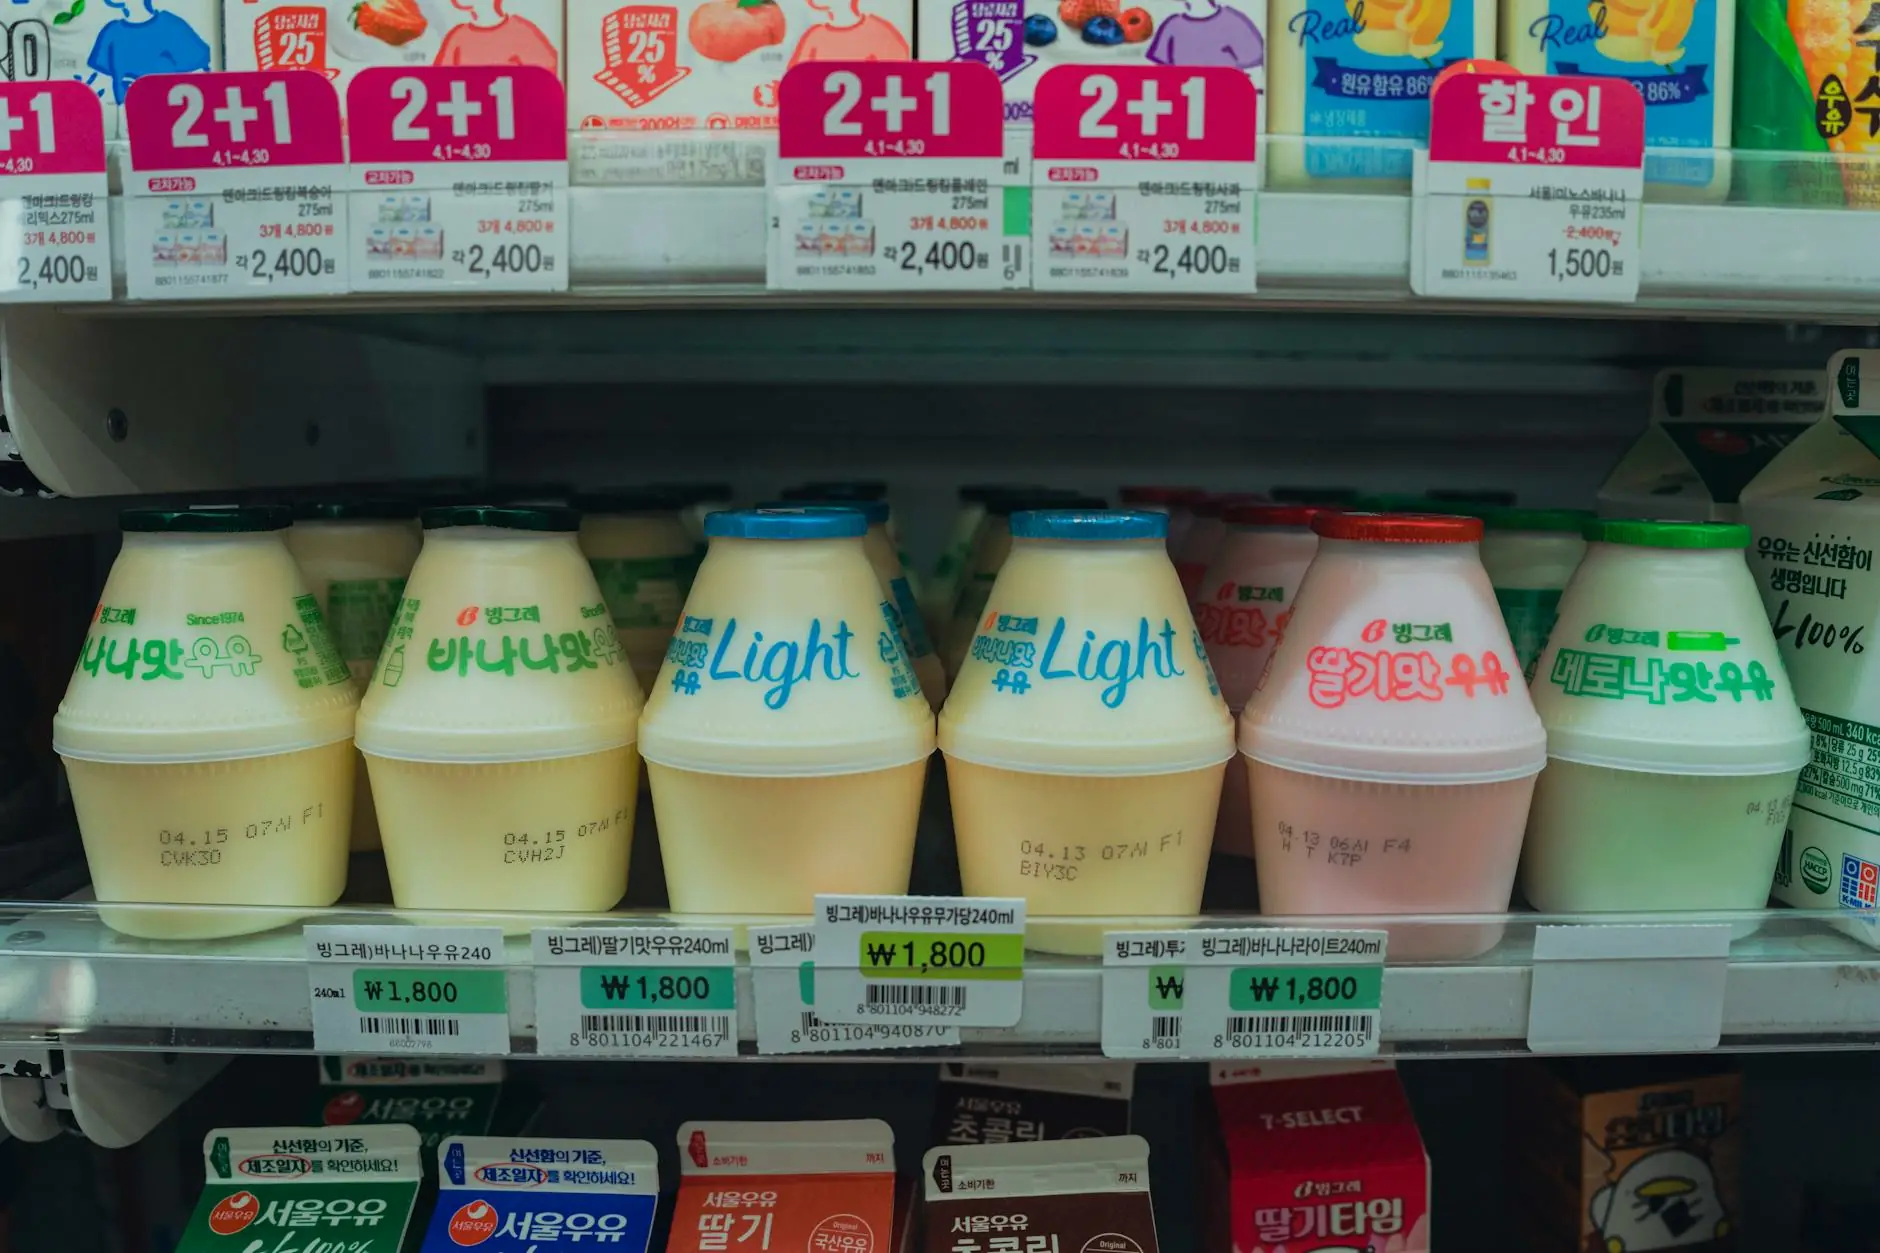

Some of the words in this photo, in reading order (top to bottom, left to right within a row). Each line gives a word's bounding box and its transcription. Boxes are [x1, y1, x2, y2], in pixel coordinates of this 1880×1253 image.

[1288, 0, 1367, 48] Real
[1528, 5, 1609, 52] Real
[975, 19, 1014, 52] 25
[278, 32, 315, 65] 25
[627, 30, 666, 63] 25
[637, 64, 656, 83] %
[1341, 73, 1404, 97] 원유함유
[1646, 81, 1681, 101] 86%
[390, 76, 515, 141] 2+1
[823, 70, 949, 137] 2+1
[1078, 74, 1206, 140] 2+1
[167, 81, 292, 148] 2+1
[298, 202, 333, 217] 275ml
[518, 200, 554, 213] 275ml
[952, 196, 988, 210] 275ml
[1204, 201, 1241, 214] 275ml
[235, 255, 248, 270] 각
[452, 250, 465, 264] 각
[884, 247, 897, 262] 각
[1136, 250, 1149, 264] 각
[1757, 537, 1801, 561] 우유는
[1803, 541, 1873, 572] 신선함이
[1770, 567, 1848, 600] 생명입니다
[100, 606, 137, 626] 빙그레
[485, 605, 540, 624] 빙그레
[1393, 622, 1453, 643] 빙그레
[709, 617, 860, 710] Light
[1039, 616, 1184, 709] Light
[1846, 723, 1865, 742] 340
[159, 828, 229, 846] 04.15
[303, 802, 323, 825] F1
[504, 829, 566, 846] 04.15
[1021, 840, 1086, 861] 04.13
[1160, 830, 1183, 852] F1
[1383, 838, 1411, 853] F4
[826, 905, 1015, 926] 빙그레)바나나우유무가당240ml
[317, 942, 492, 961] 빙그레)바나나우유240
[548, 935, 729, 956] 빙그레)딸기맛우유240ml
[1202, 936, 1381, 958] 빙그레)바나나라이트240ml
[1260, 1106, 1363, 1130] 7-SELECT
[272, 1139, 332, 1154] 신선함의
[335, 1138, 369, 1154] 기준,
[327, 1158, 399, 1173] 확인하세요!
[509, 1149, 569, 1164] 신선함의
[572, 1150, 606, 1166] 기준,
[563, 1170, 636, 1185] 확인하세요!
[958, 1178, 995, 1190] 소비기한
[1118, 1172, 1137, 1184] 까지
[702, 1191, 777, 1208] 서울우유
[255, 1199, 387, 1227] 서울우유
[1254, 1198, 1403, 1243] 딸기타임
[495, 1212, 628, 1243] 서울우유
[698, 1212, 773, 1250] 딸기
[951, 1214, 1029, 1234] 서울우유
[1099, 1240, 1126, 1249] Original
